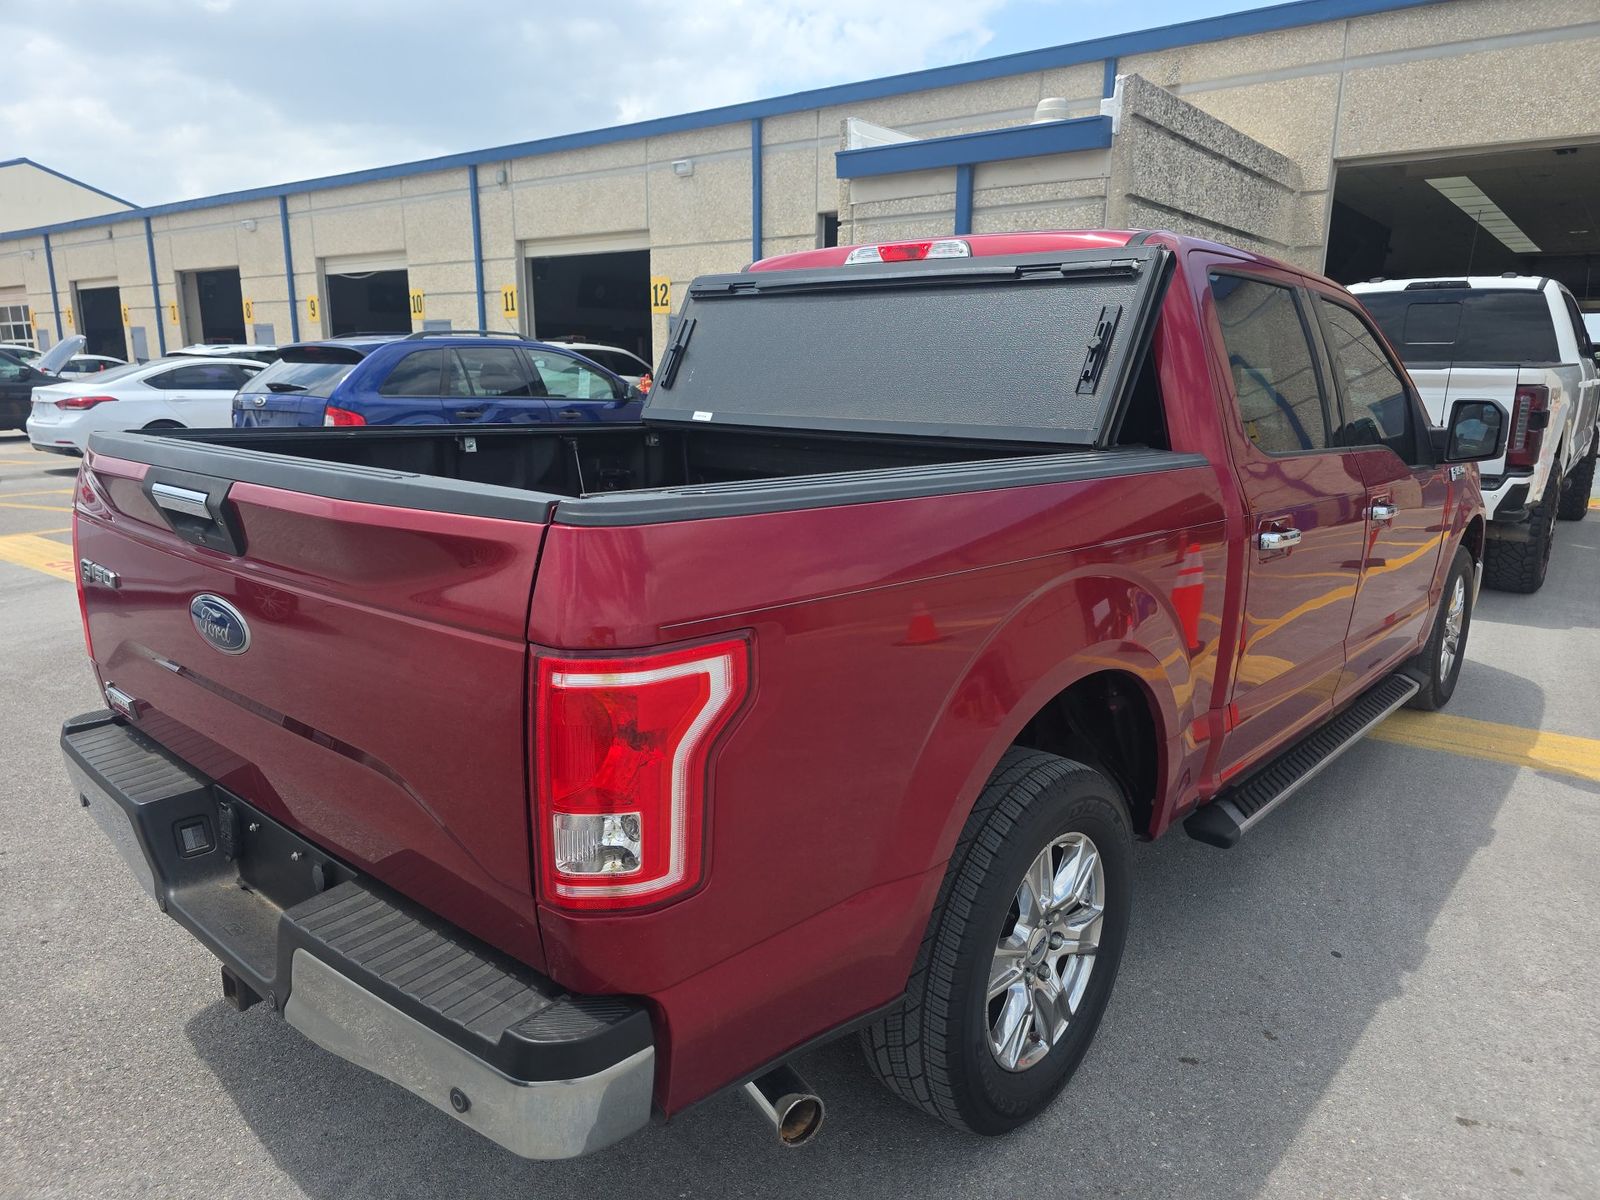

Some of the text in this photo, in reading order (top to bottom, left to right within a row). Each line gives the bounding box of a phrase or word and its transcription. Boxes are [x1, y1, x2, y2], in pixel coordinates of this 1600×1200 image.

[412, 294, 423, 314] 10
[503, 290, 515, 312] 11
[652, 283, 669, 307] 12
[244, 302, 252, 319] 8
[309, 299, 316, 317] 9
[199, 606, 231, 643] Ford
